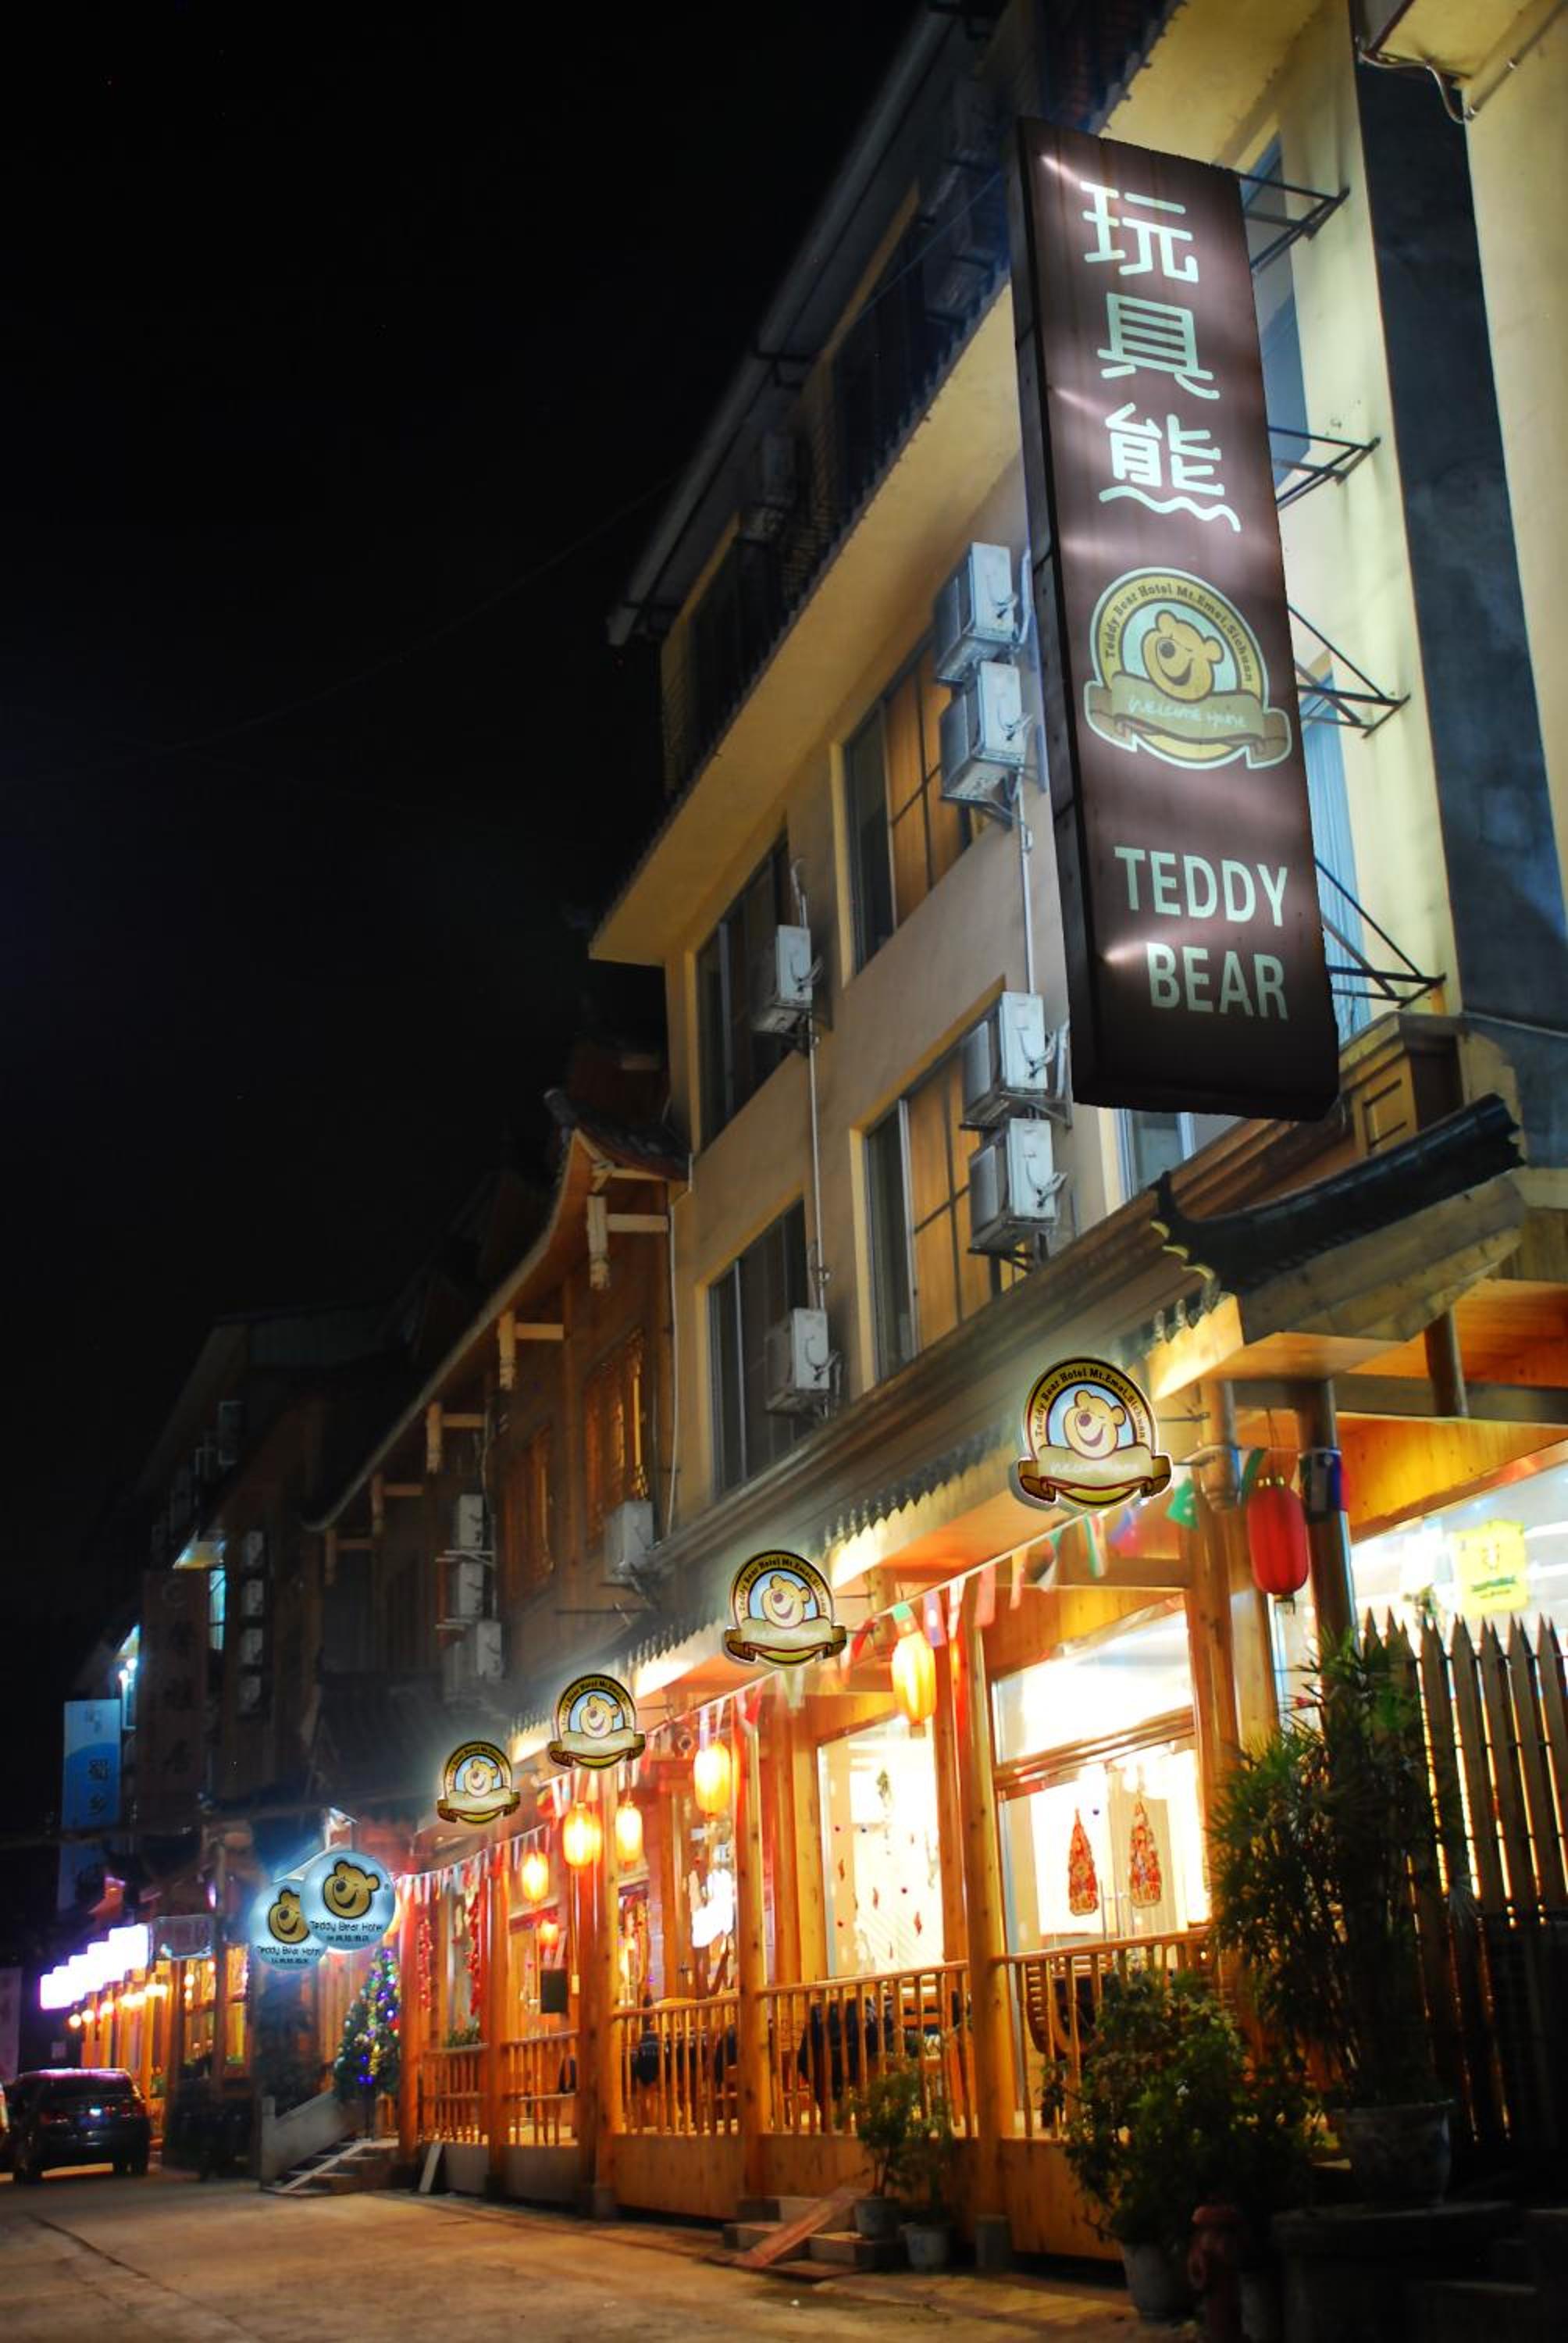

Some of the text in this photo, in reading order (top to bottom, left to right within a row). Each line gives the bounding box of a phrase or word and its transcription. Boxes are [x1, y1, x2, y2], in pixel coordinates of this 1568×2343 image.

[1103, 619, 1120, 658] Teddy
[1114, 593, 1138, 615] Bear
[1138, 583, 1172, 597] Hotel
[1114, 846, 1288, 927] TEDDY
[1146, 942, 1288, 1019] BEAR
[1042, 1380, 1060, 1401] Bear
[1060, 1368, 1087, 1382] Hotel
[339, 1921, 359, 1931] Bear
